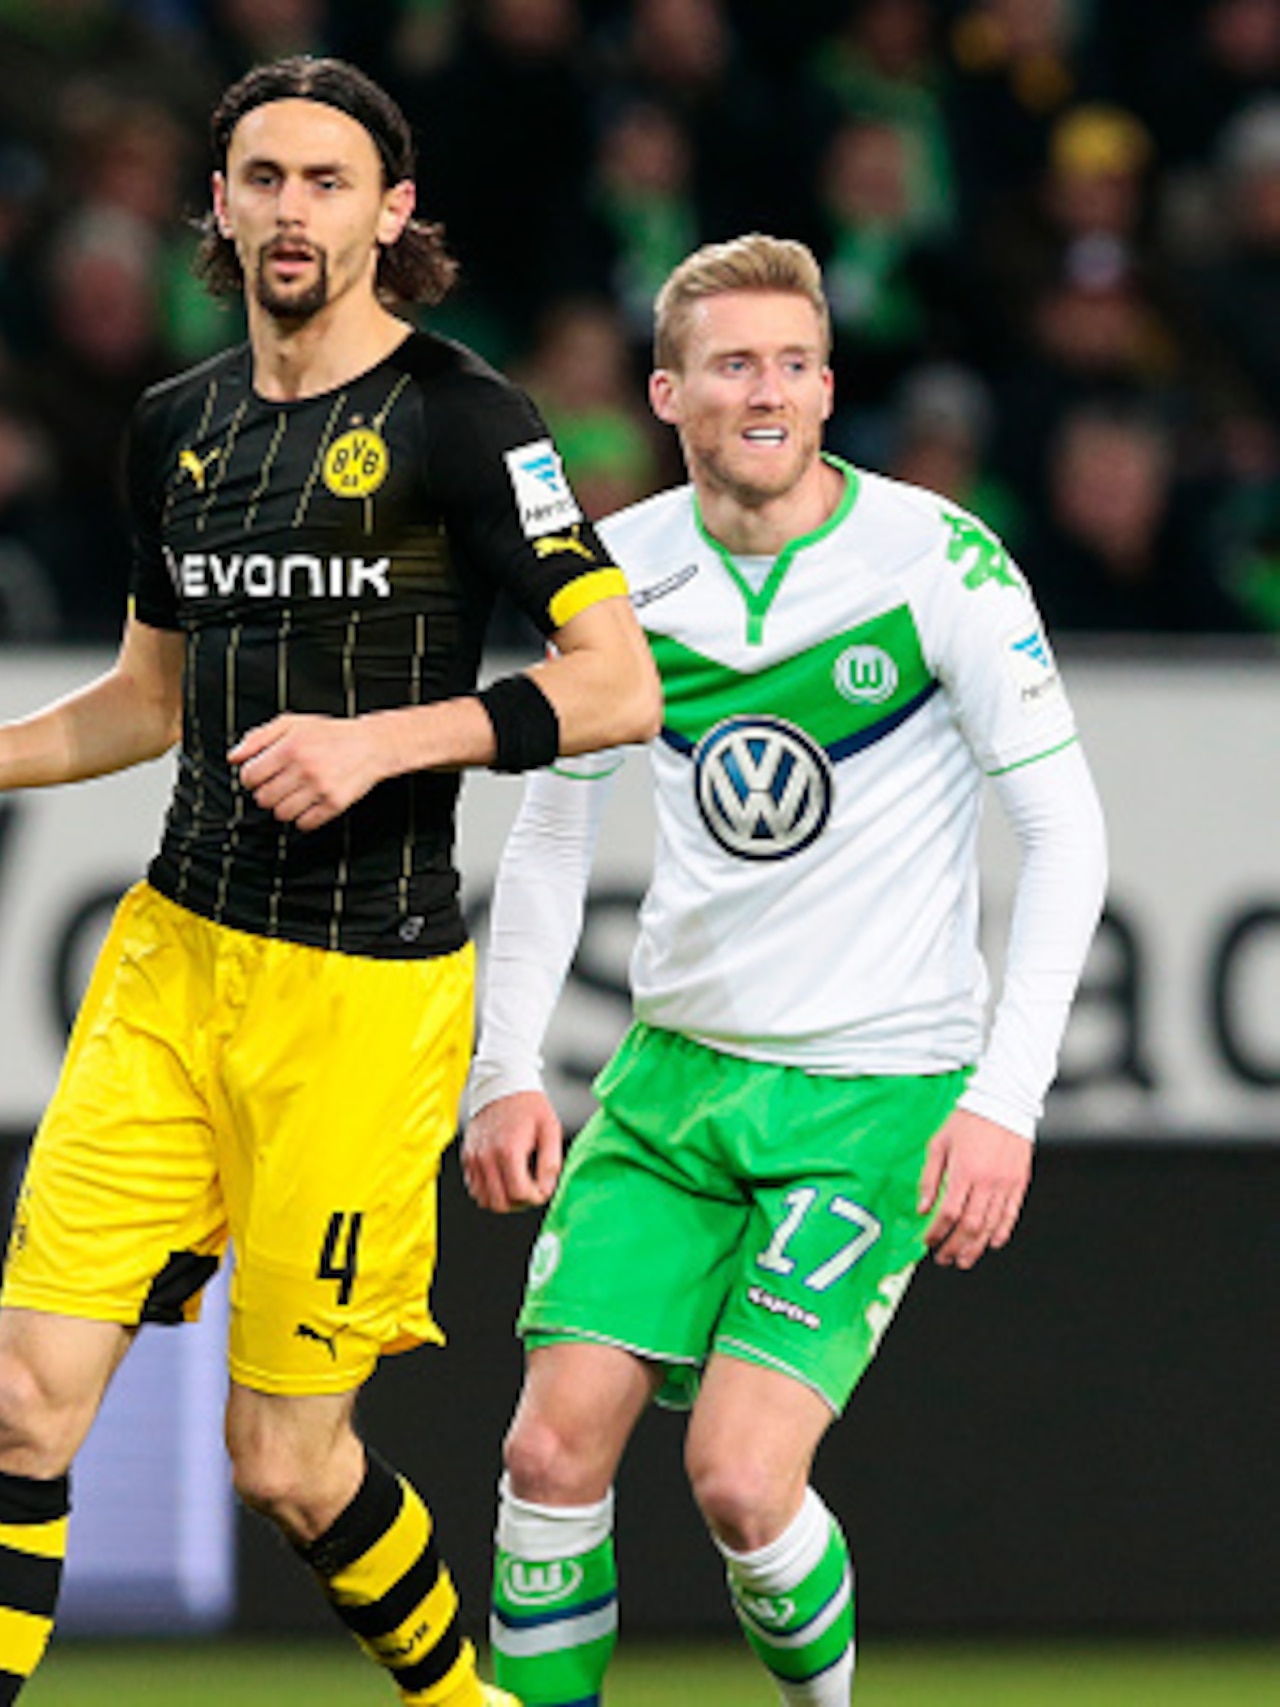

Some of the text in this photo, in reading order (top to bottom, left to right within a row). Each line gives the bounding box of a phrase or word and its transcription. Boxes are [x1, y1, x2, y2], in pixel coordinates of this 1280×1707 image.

[182, 553, 391, 598] EVONIK
[314, 1211, 365, 1306] 4
[755, 1185, 883, 1293] 17
